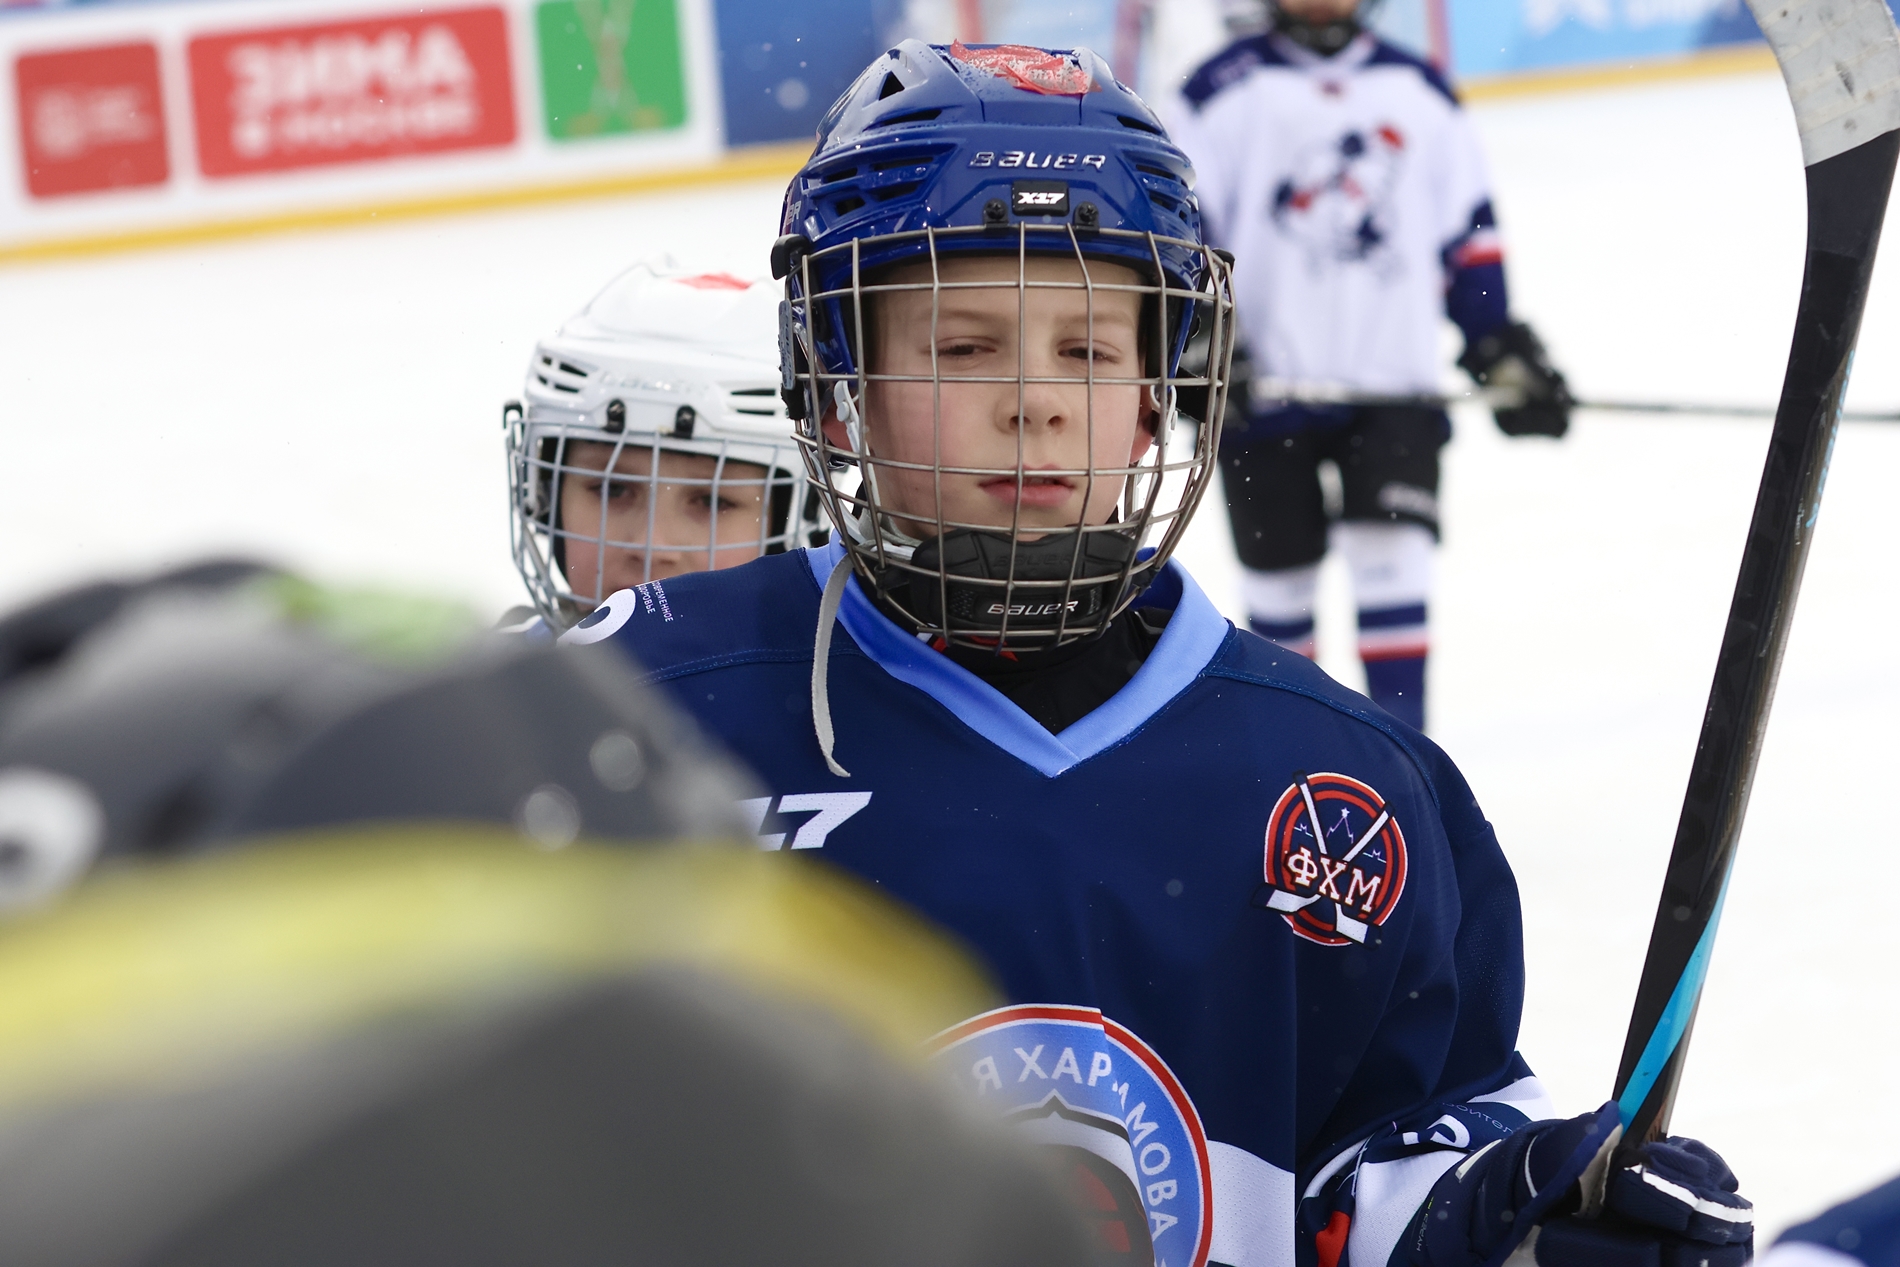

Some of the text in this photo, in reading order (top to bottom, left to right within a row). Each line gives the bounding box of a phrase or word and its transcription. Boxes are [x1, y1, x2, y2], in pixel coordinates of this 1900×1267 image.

[968, 150, 1106, 172] BAUER
[1017, 191, 1065, 204] X17
[1287, 846, 1382, 913] ФХМ
